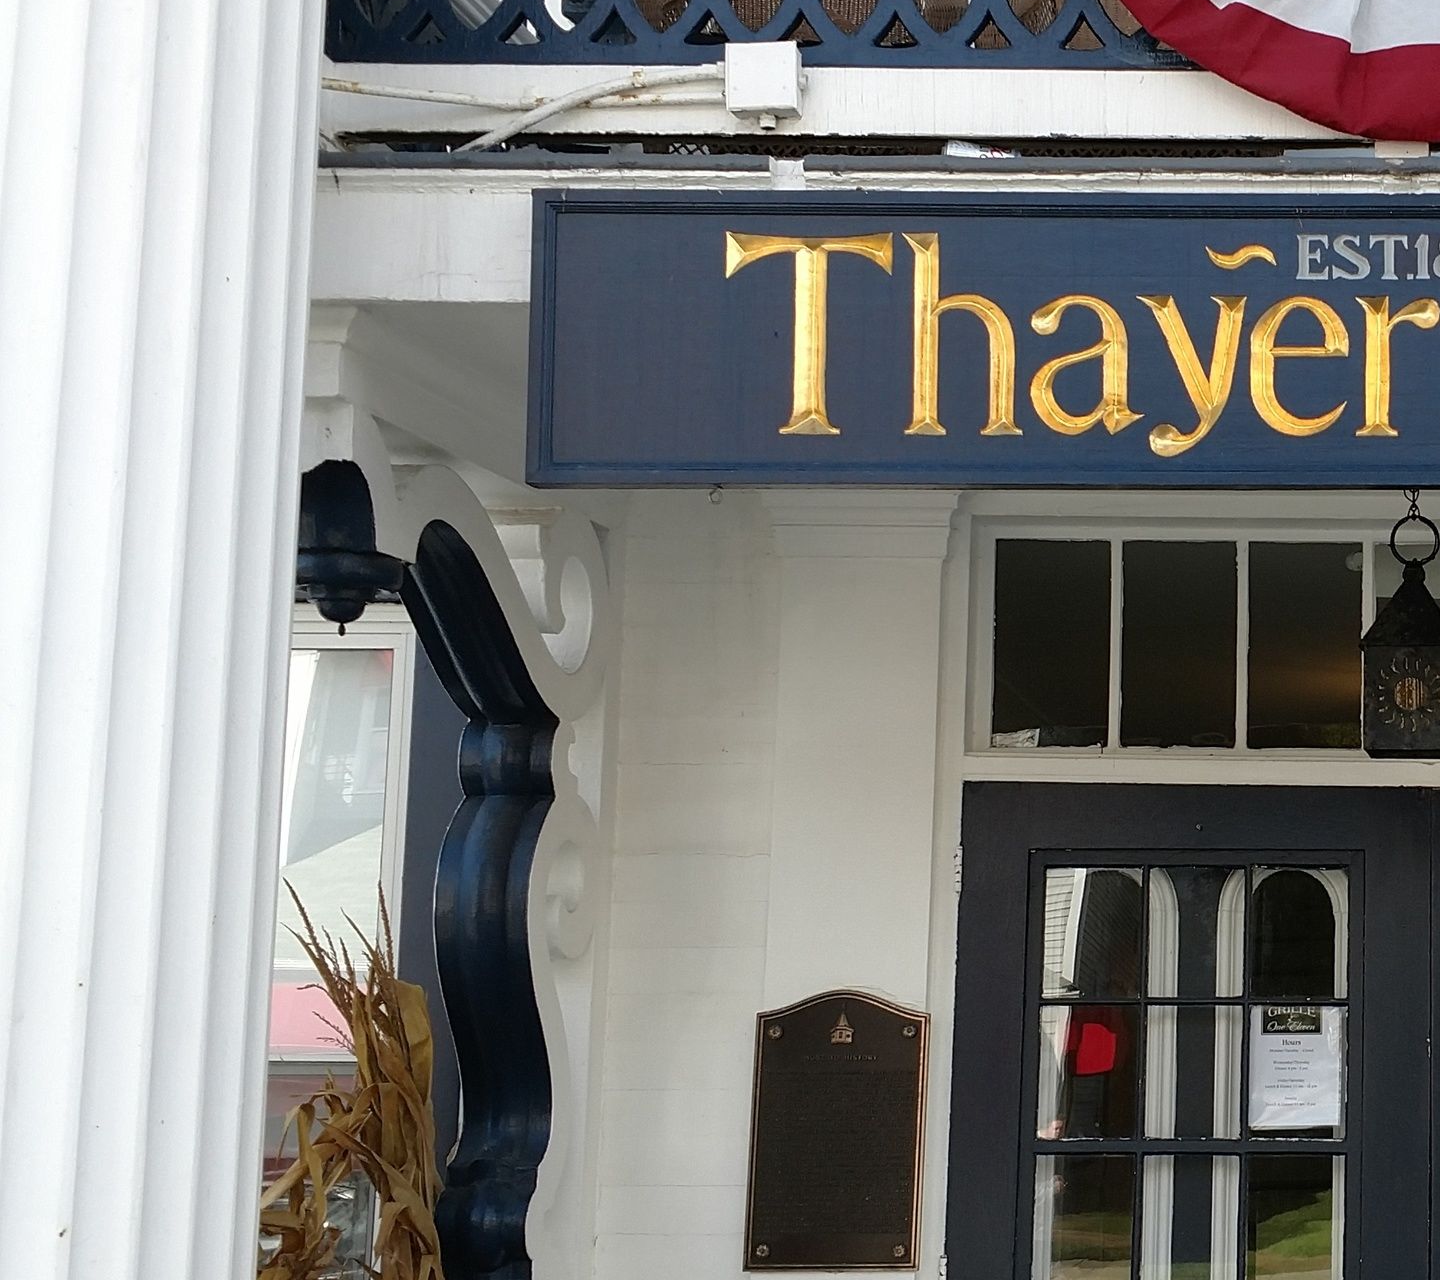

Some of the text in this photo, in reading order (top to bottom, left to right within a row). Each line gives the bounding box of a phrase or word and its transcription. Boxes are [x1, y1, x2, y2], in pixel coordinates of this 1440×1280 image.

[1267, 1006, 1317, 1018] GRILLE
[1267, 1020, 1316, 1032] One Eleven
